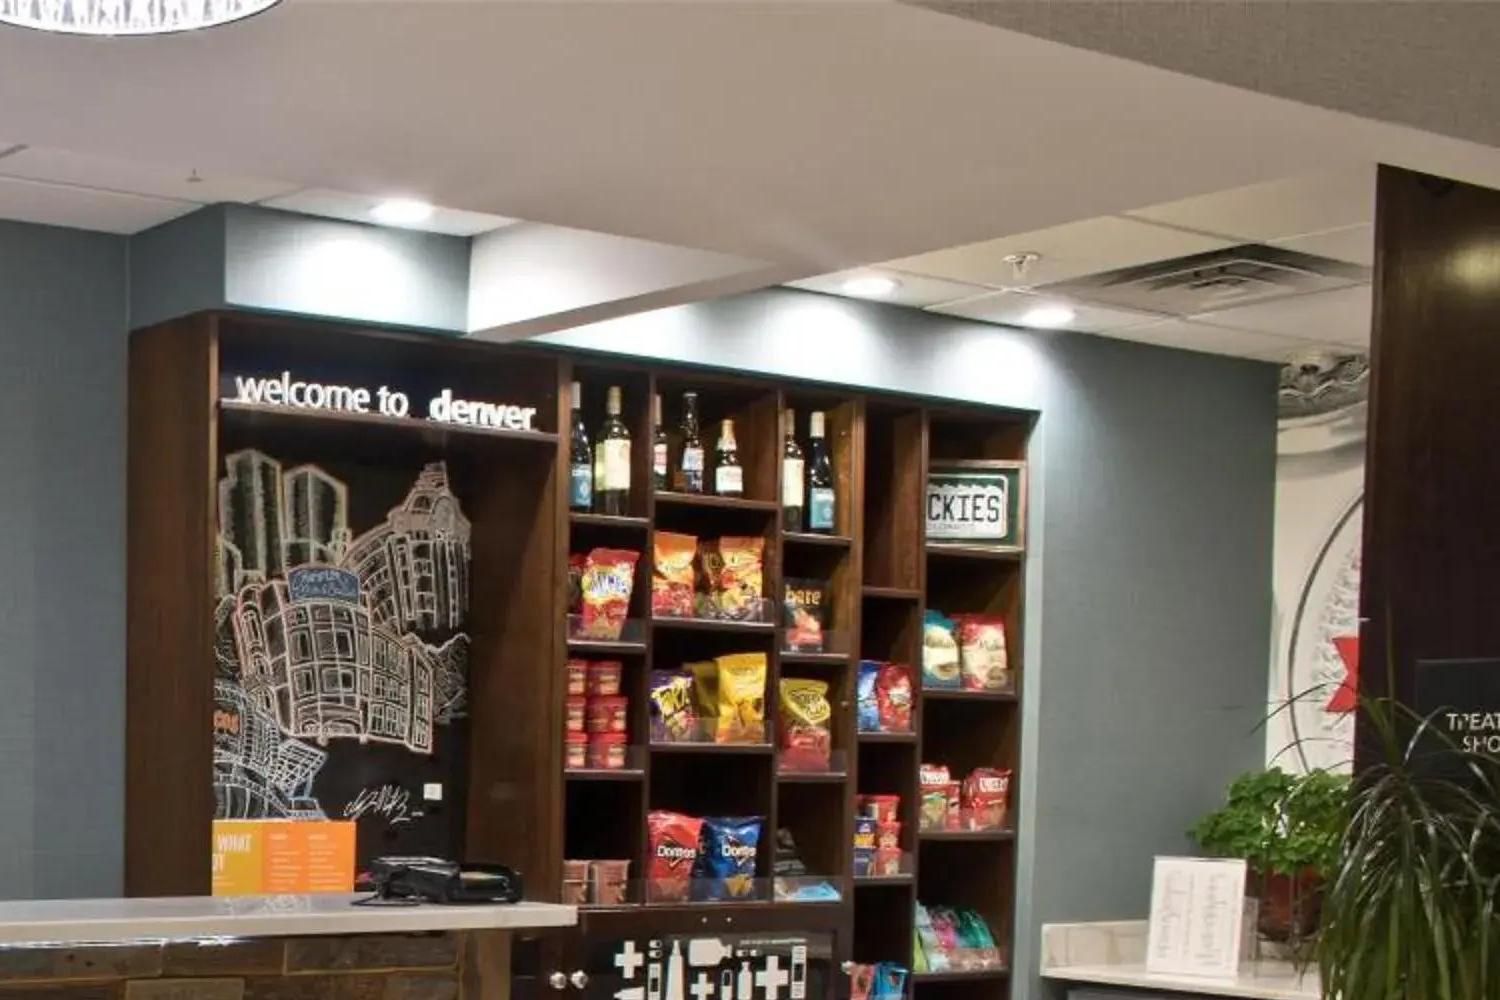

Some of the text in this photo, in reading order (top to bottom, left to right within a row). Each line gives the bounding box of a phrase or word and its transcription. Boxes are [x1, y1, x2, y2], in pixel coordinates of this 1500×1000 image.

[236, 371, 536, 431] welcome to denver
[928, 493, 1000, 523] CKIES
